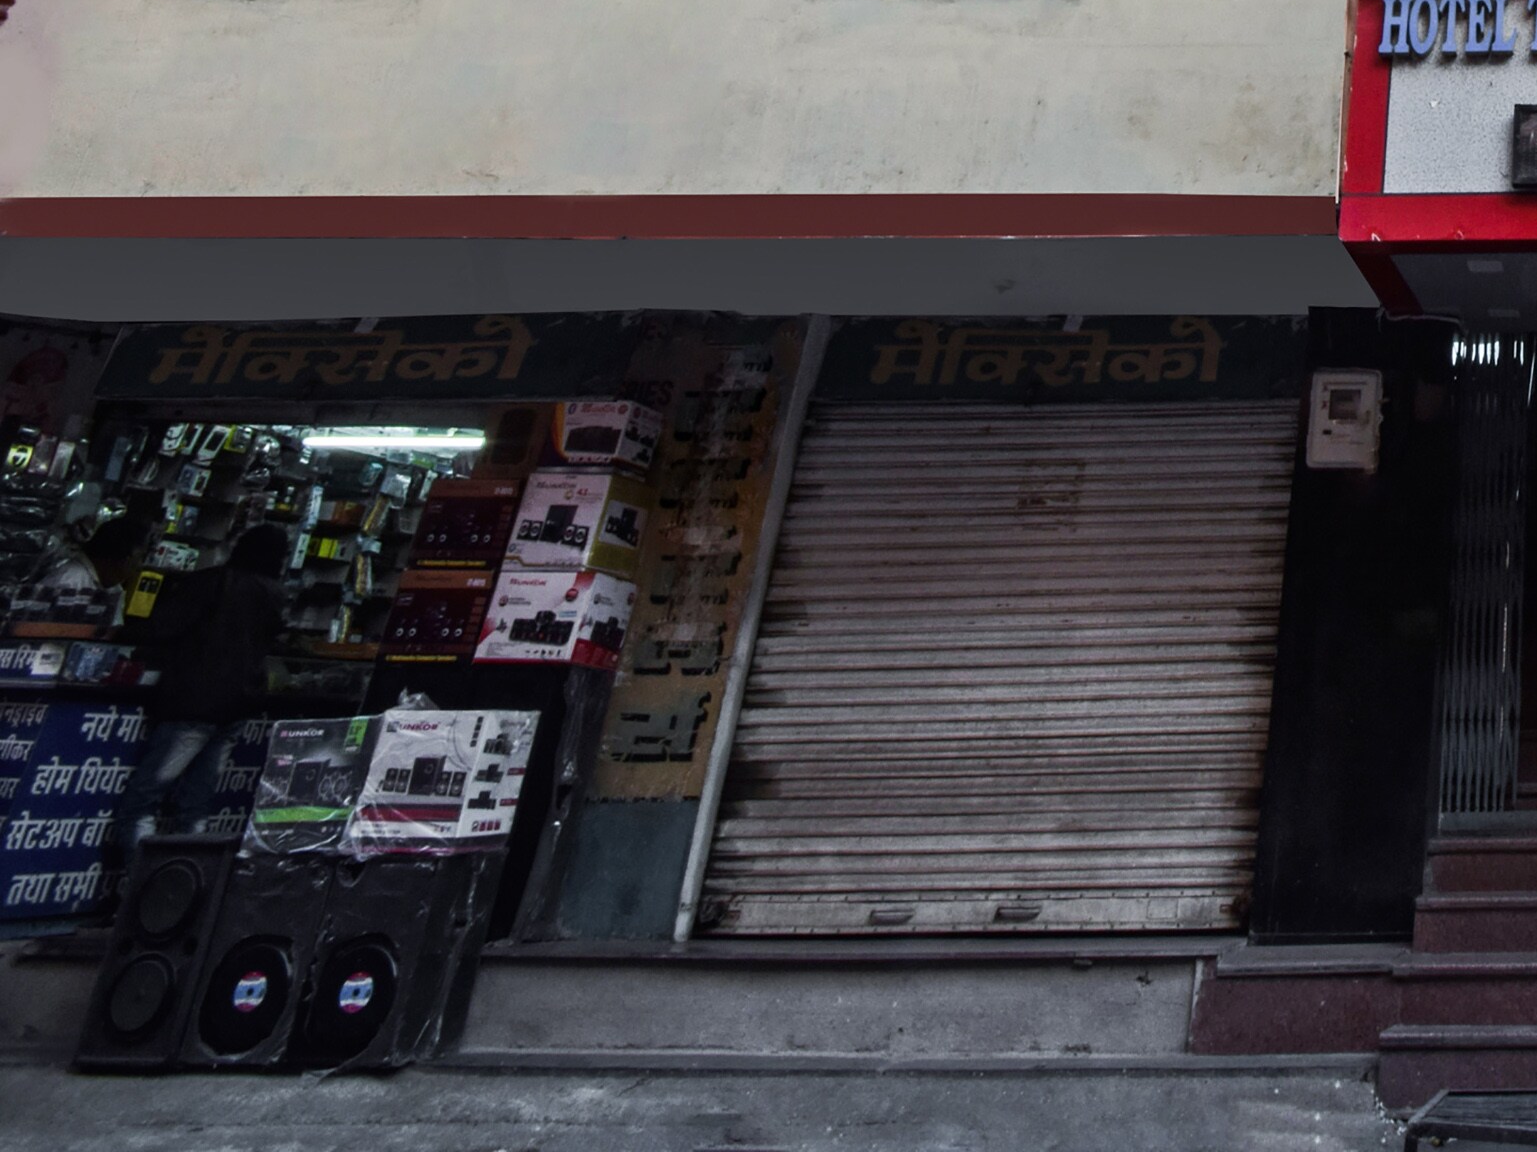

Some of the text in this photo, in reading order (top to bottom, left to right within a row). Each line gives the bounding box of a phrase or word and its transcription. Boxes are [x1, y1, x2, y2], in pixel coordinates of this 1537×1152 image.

[80, 705, 119, 743] नये
[31, 755, 79, 795] होम
[6, 872, 56, 905] तथा
